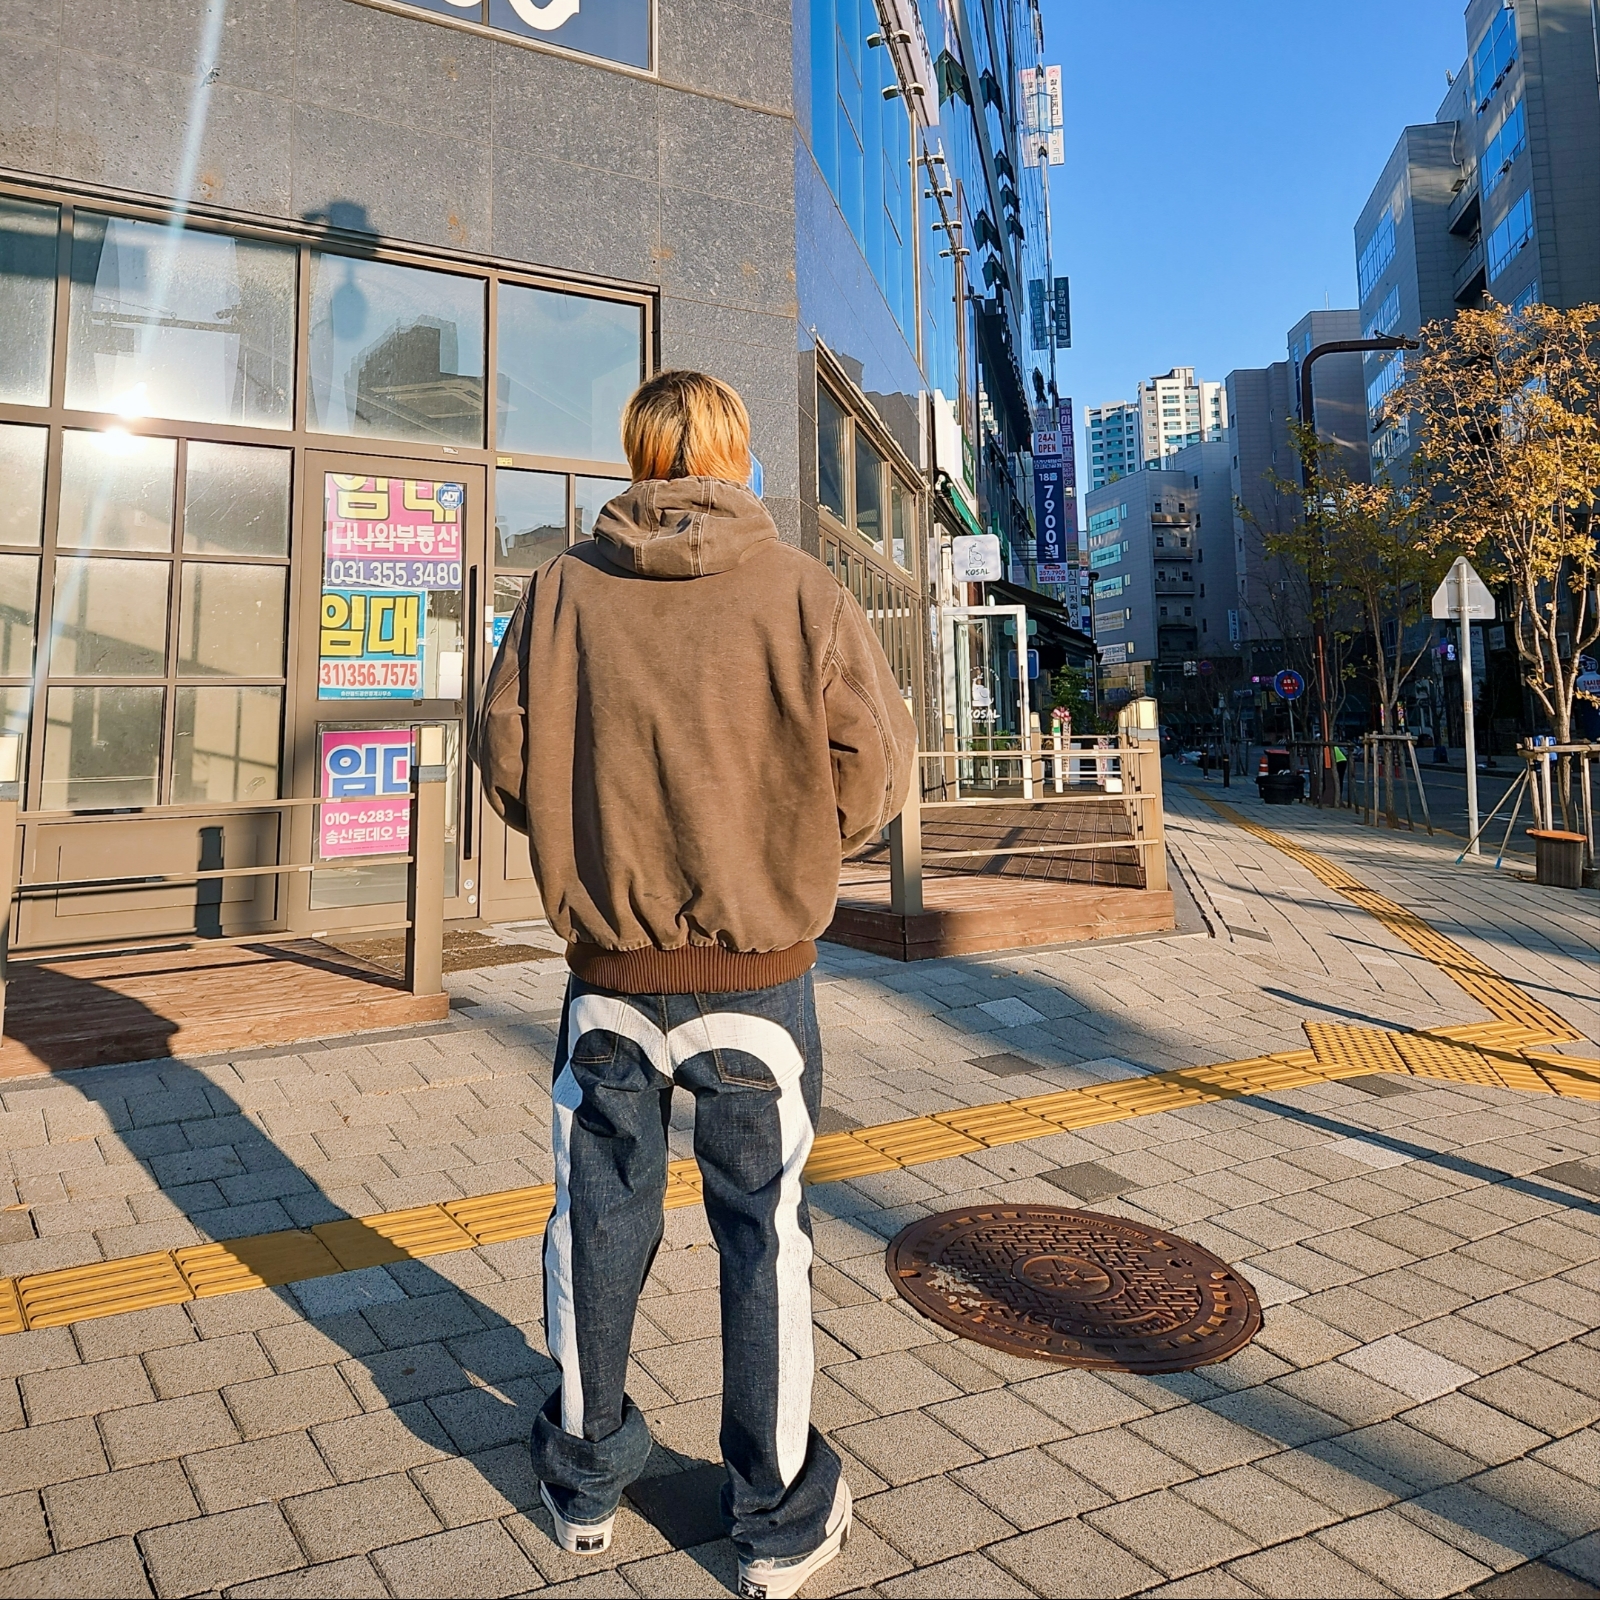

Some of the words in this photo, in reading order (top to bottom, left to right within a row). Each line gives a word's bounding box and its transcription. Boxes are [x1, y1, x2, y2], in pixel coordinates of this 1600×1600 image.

[1037, 433, 1056, 443] 24시
[1038, 443, 1057, 453] OPEN
[441, 491, 459, 502] ADT
[1044, 485, 1060, 559] 7900원
[331, 560, 462, 586] 031.355.3480
[965, 568, 990, 576] KOSAL
[1068, 570, 1079, 628] 시그니처독서실
[320, 593, 421, 657] 임대
[966, 709, 1001, 719] KOSAL
[325, 827, 394, 845] 송산로데오
